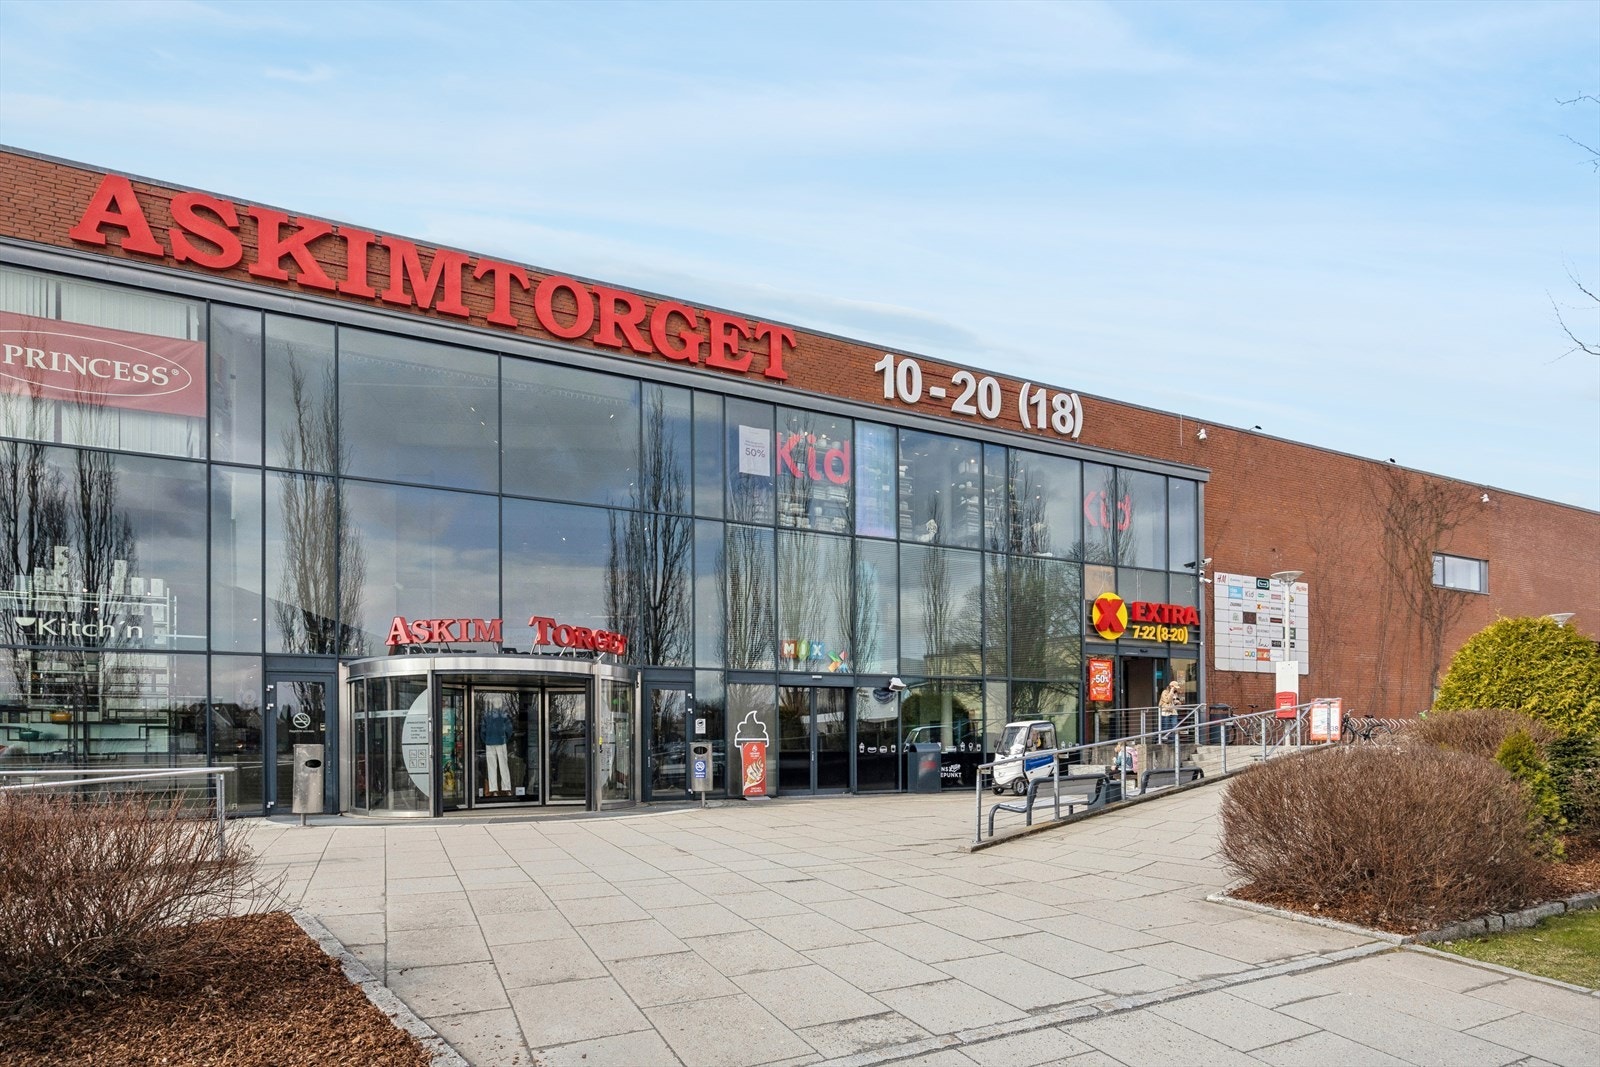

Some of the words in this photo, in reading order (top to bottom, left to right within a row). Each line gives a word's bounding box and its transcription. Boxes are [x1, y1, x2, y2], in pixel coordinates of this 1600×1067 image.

[1018, 382, 1083, 439] (18)
[745, 447, 765, 458] 50%
[776, 431, 850, 485] Kid
[1131, 601, 1199, 625] EXTRA
[385, 616, 503, 646] ASKIM
[528, 616, 628, 656] TORGET
[782, 642, 823, 657] MIX
